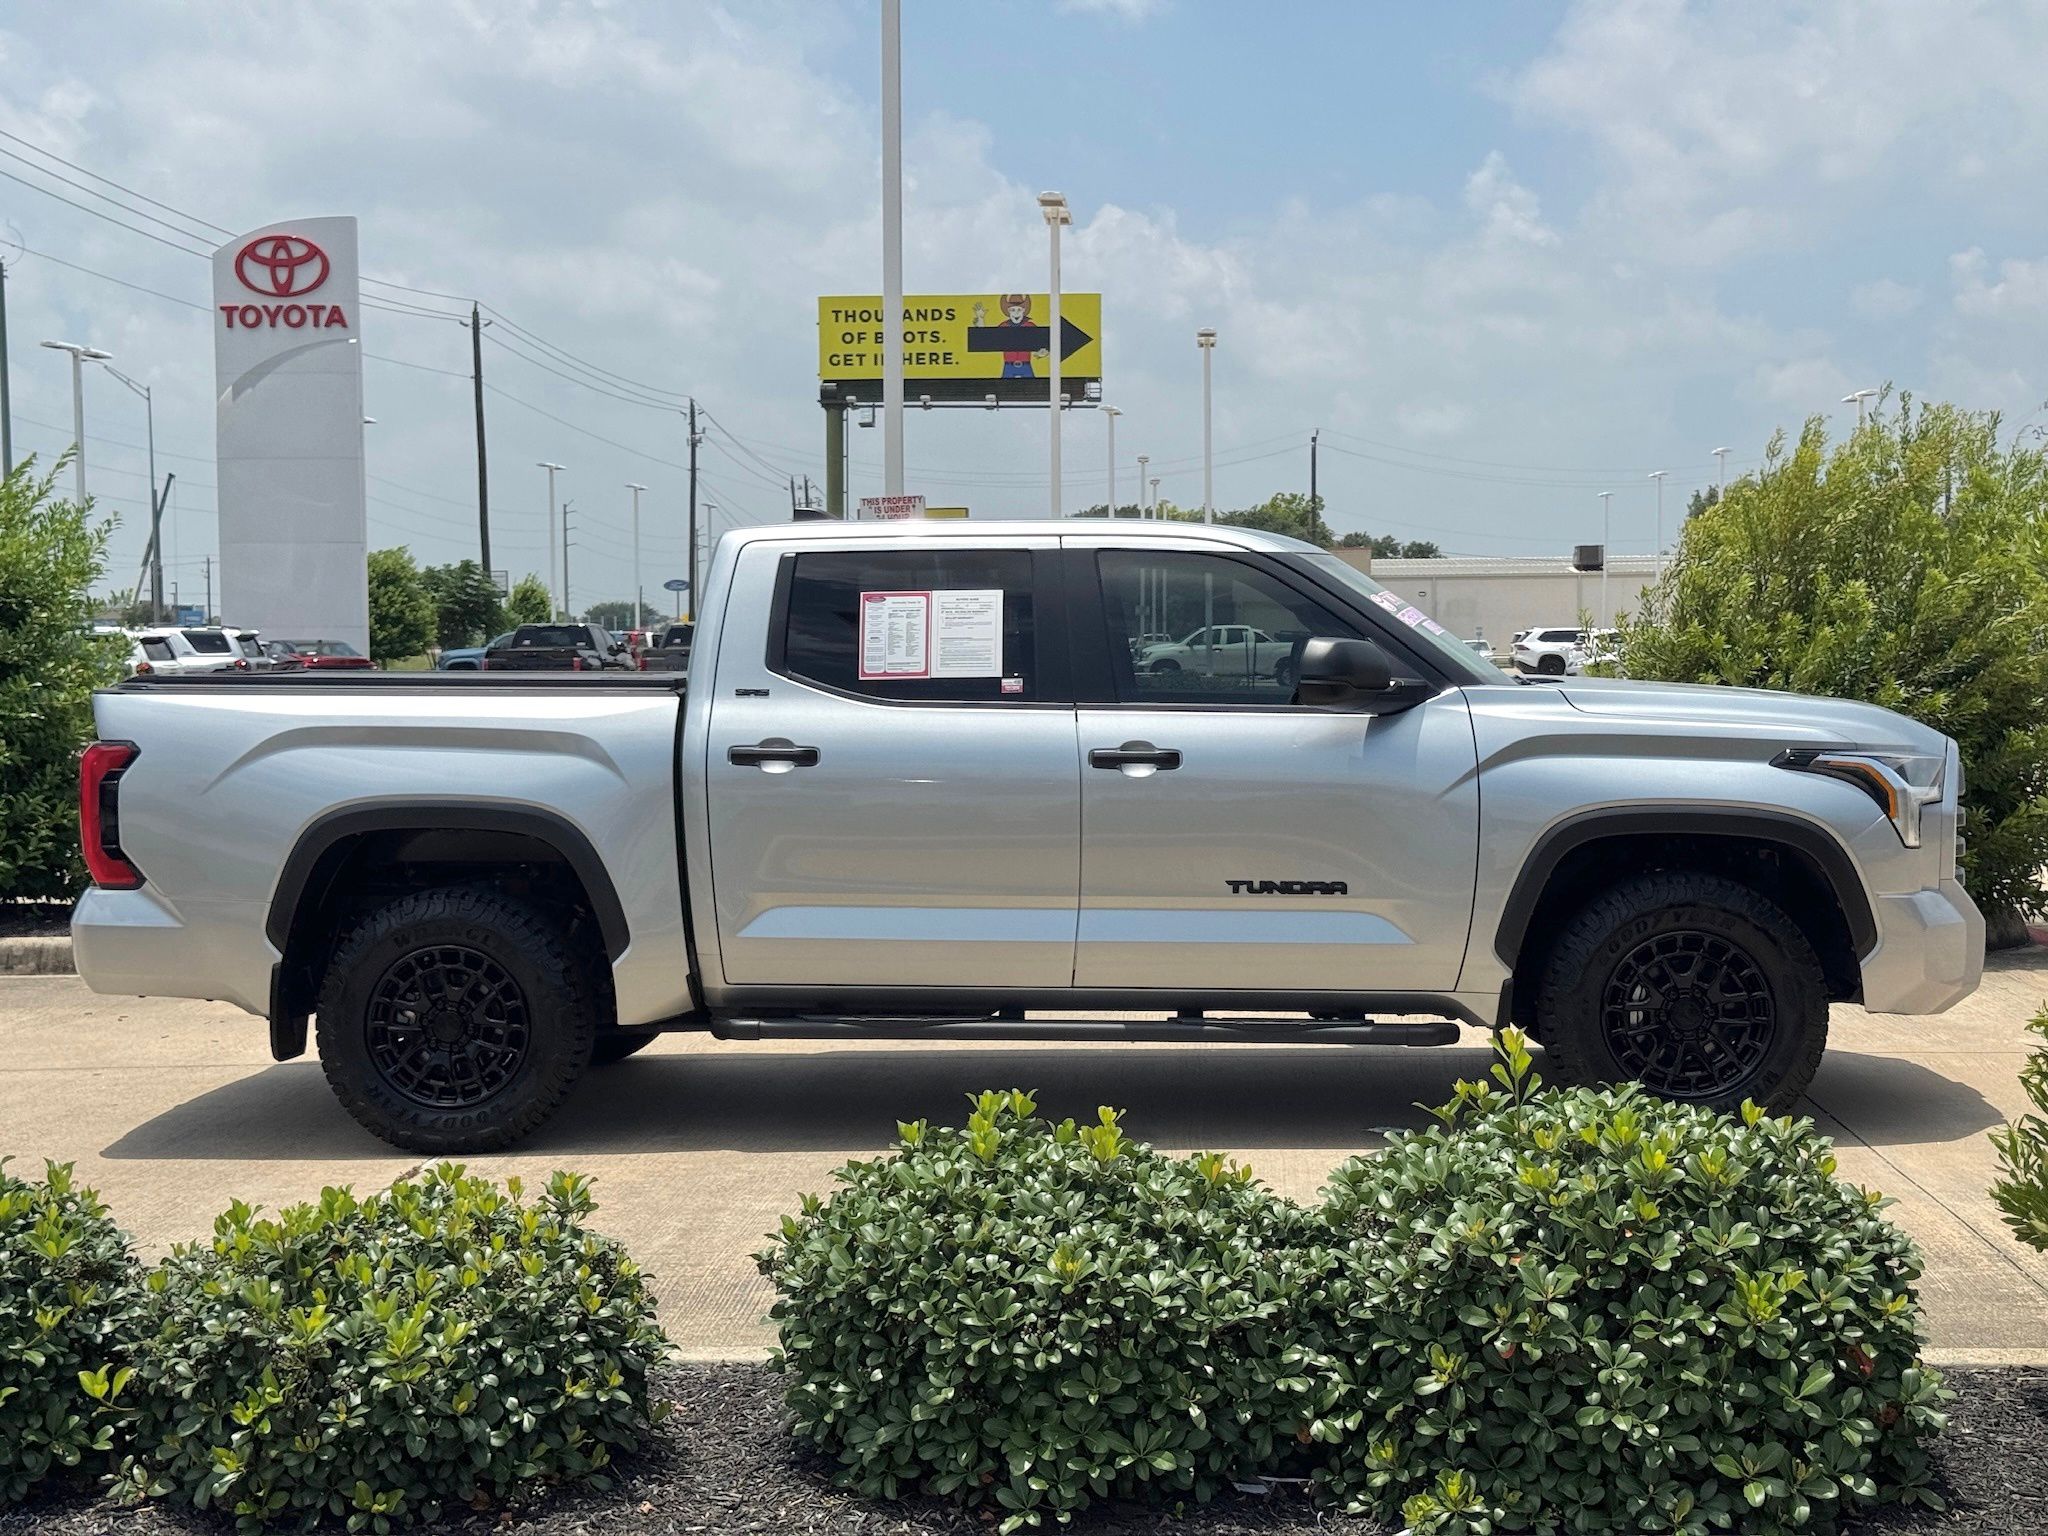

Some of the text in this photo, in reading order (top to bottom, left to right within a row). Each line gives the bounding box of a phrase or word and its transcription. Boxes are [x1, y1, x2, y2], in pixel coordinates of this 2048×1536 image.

[220, 304, 348, 328] TOYOTA
[831, 309, 956, 323] THOUANDS
[841, 330, 946, 345] OF BOTS.
[829, 354, 867, 366] GET
[902, 352, 960, 365] HERE.
[861, 495, 923, 506] THIS PROPERTY
[874, 504, 911, 514] IS UNDER
[1225, 880, 1348, 895] TUNDRA
